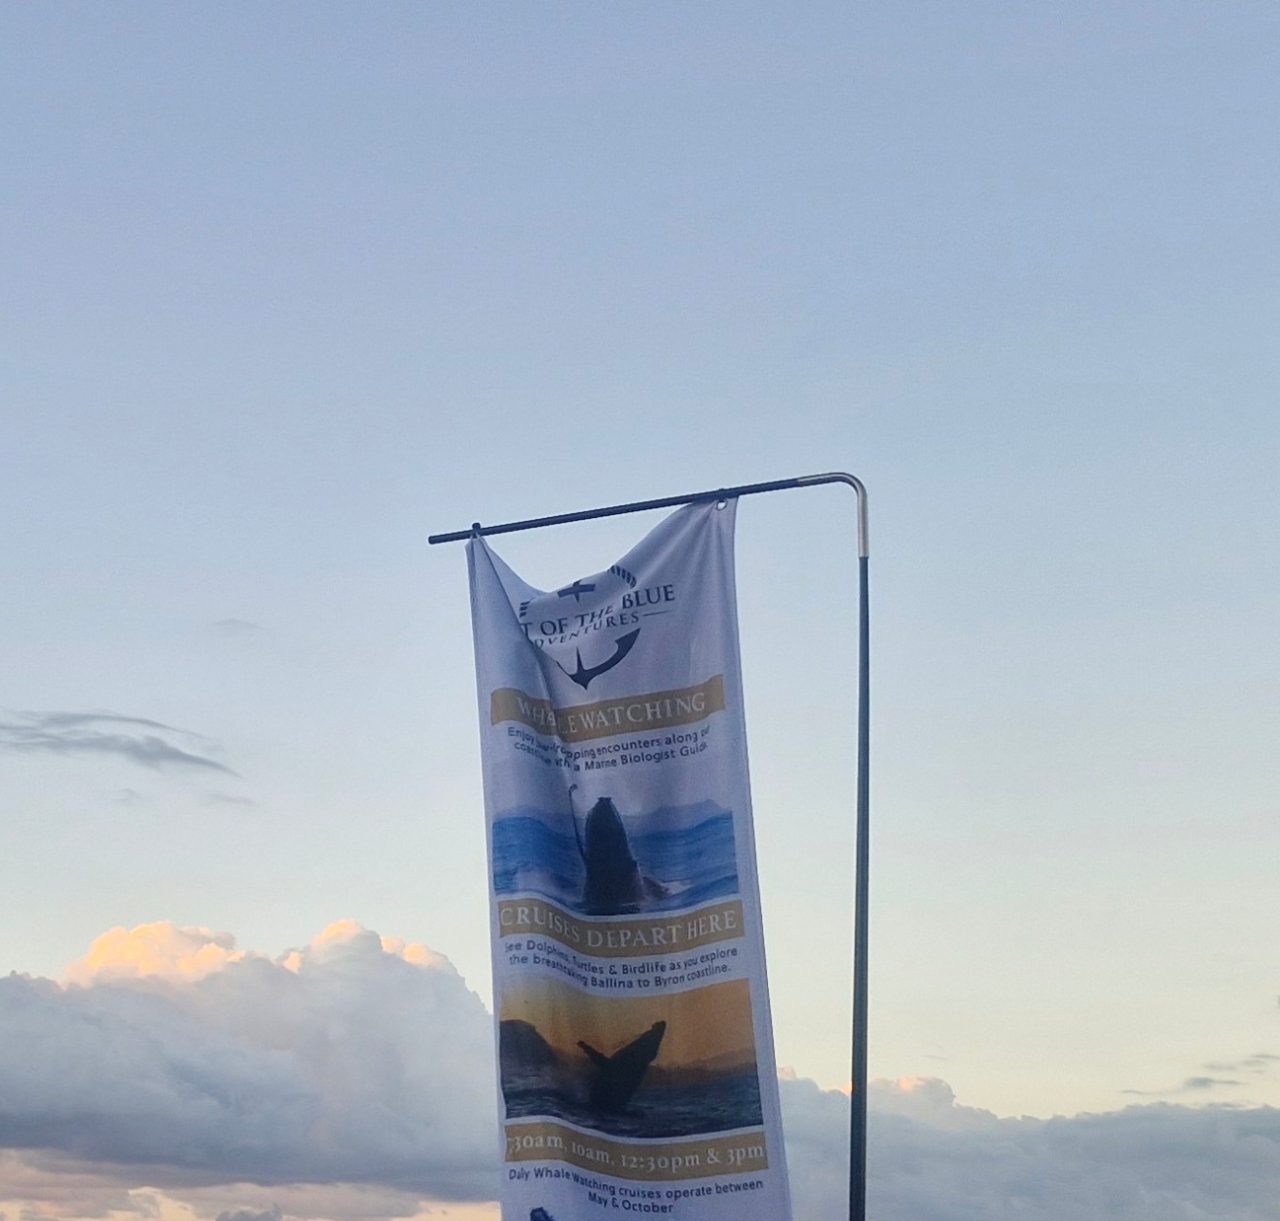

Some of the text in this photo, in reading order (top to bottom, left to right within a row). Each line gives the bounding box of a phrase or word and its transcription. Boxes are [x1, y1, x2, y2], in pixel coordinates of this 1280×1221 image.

[539, 617, 568, 637] OF
[574, 605, 614, 628] THE
[622, 584, 676, 610] BLUE
[534, 613, 640, 648] DVENTURES
[578, 692, 706, 729] WATCHING
[597, 737, 661, 758] encounters
[665, 732, 698, 744] along
[500, 907, 737, 949] CRUISES DEPART HERE
[608, 964, 618, 975] &
[622, 961, 666, 975] Birdlife
[669, 961, 681, 971] as
[683, 957, 699, 969] you
[699, 947, 738, 963] explore
[591, 976, 634, 989] Ballina
[637, 978, 650, 988] to
[654, 975, 686, 988] Byron
[620, 1153, 701, 1174] 12:30pm
[706, 1148, 720, 1165] &
[727, 1145, 764, 1166] 3pm
[533, 1167, 571, 1179] Whale
[618, 1187, 662, 1199] cruises
[665, 1184, 713, 1201] operate
[715, 1180, 764, 1194] between
[622, 1199, 673, 1213] October
